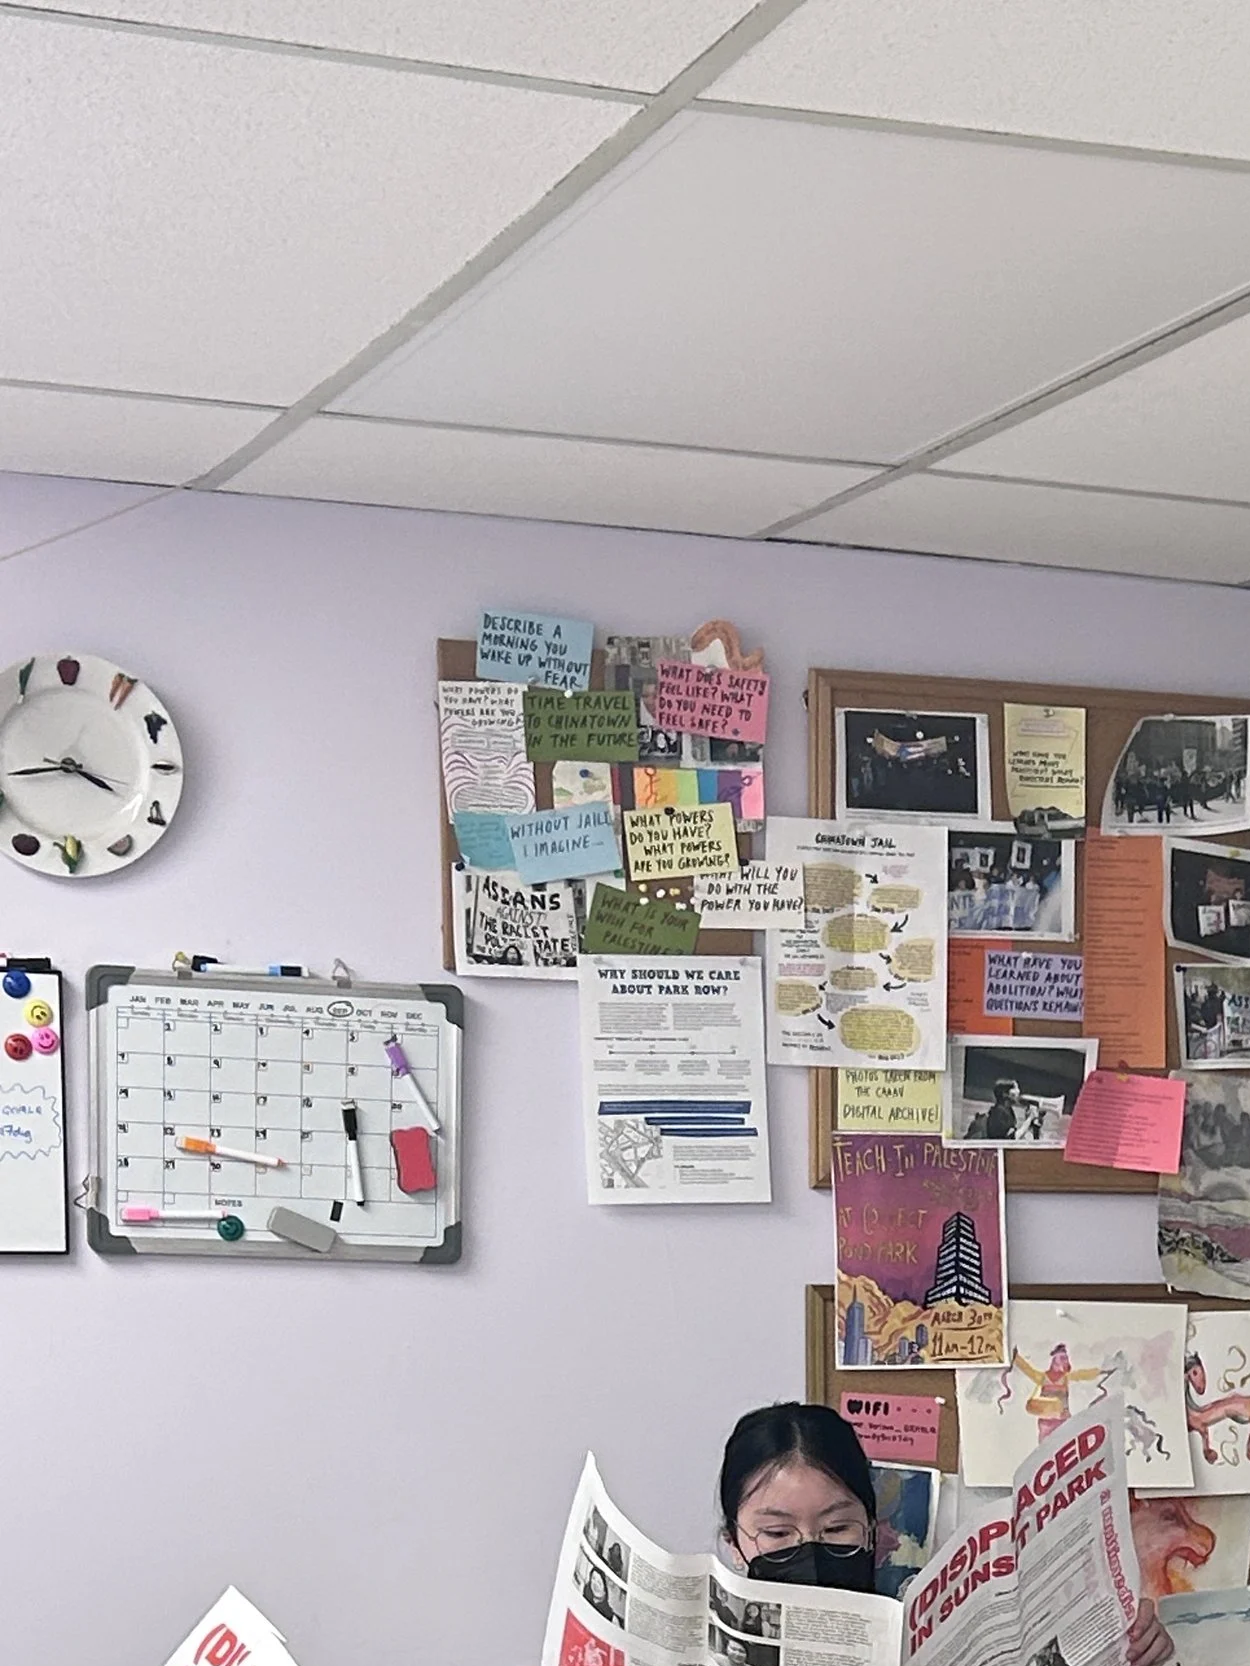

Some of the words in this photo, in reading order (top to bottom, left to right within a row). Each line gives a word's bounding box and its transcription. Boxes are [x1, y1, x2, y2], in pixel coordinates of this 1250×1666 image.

[483, 613, 543, 636] DESCRIBE
[553, 625, 562, 638] A
[482, 632, 538, 651] MORNING
[545, 643, 568, 656] YOU
[480, 648, 511, 664] WAKE
[518, 653, 532, 667] UP
[538, 657, 589, 676] WITHOUT
[544, 671, 583, 690] FEAR
[660, 664, 692, 683] WHAT
[530, 695, 565, 711] TIME
[575, 696, 630, 711] TRAVEL
[660, 681, 682, 695] FEEL
[686, 685, 718, 699] LIKE?
[721, 690, 753, 707] WHAT
[659, 697, 672, 709] DO
[676, 699, 697, 713] YOU
[701, 704, 732, 719] NEED
[739, 709, 752, 721] TO
[527, 714, 541, 729] TO
[548, 715, 632, 730] CHINATOWN
[659, 711, 685, 727] FEEL
[690, 717, 728, 733] SAFE?
[526, 733, 543, 747] IN
[551, 733, 576, 747] THE
[587, 733, 639, 749] FUTURE
[510, 816, 570, 840] WITHOUT
[630, 814, 662, 828] WHAT
[669, 809, 714, 825] POWERS
[629, 832, 644, 845] DO
[647, 830, 668, 842] YOU
[672, 823, 712, 840] HAVE?
[870, 835, 897, 849] JAIL
[643, 843, 674, 856] WHAT
[680, 840, 723, 854] POWERS
[634, 861, 652, 873] ARE
[657, 858, 673, 871] YOU
[678, 853, 731, 870] GROWING?
[740, 865, 769, 880] WILL
[776, 866, 798, 881] YOU
[482, 877, 561, 911] ASIANS
[707, 882, 721, 895] DO
[726, 883, 752, 895] WITH
[757, 883, 779, 895] THE
[701, 898, 741, 913] POWER
[749, 899, 770, 912] YOU
[772, 896, 804, 914] HAVE?
[479, 911, 498, 934] THE
[502, 920, 550, 939] RACIST
[661, 912, 689, 932] YOUR
[988, 954, 1019, 968] WHAT
[1022, 957, 1054, 970] HAVE
[1060, 958, 1083, 971] YOU
[598, 969, 626, 980] WHY
[631, 969, 680, 980] SHOULD
[685, 970, 704, 981] WE
[709, 970, 741, 981] CARE
[988, 967, 1040, 982] LEARNED
[1044, 973, 1083, 986] ABOUT
[611, 984, 653, 995] ABOUT
[658, 985, 690, 995] PARK
[694, 985, 729, 996] ROW?
[987, 982, 1055, 997] ABOLITION?
[155, 996, 171, 1004] FEB
[180, 998, 199, 1006] MAR
[356, 1009, 373, 1017] OCT
[406, 1012, 423, 1020] DEC
[986, 998, 1040, 1012] QUESTIONS
[855, 1086, 870, 1097] THE
[843, 1104, 884, 1120] DIGITAL
[877, 1241, 918, 1265] PARK
[847, 1399, 890, 1417] WIFI
[910, 1615, 934, 1658] IN
[1036, 1458, 1108, 1533] PARK
